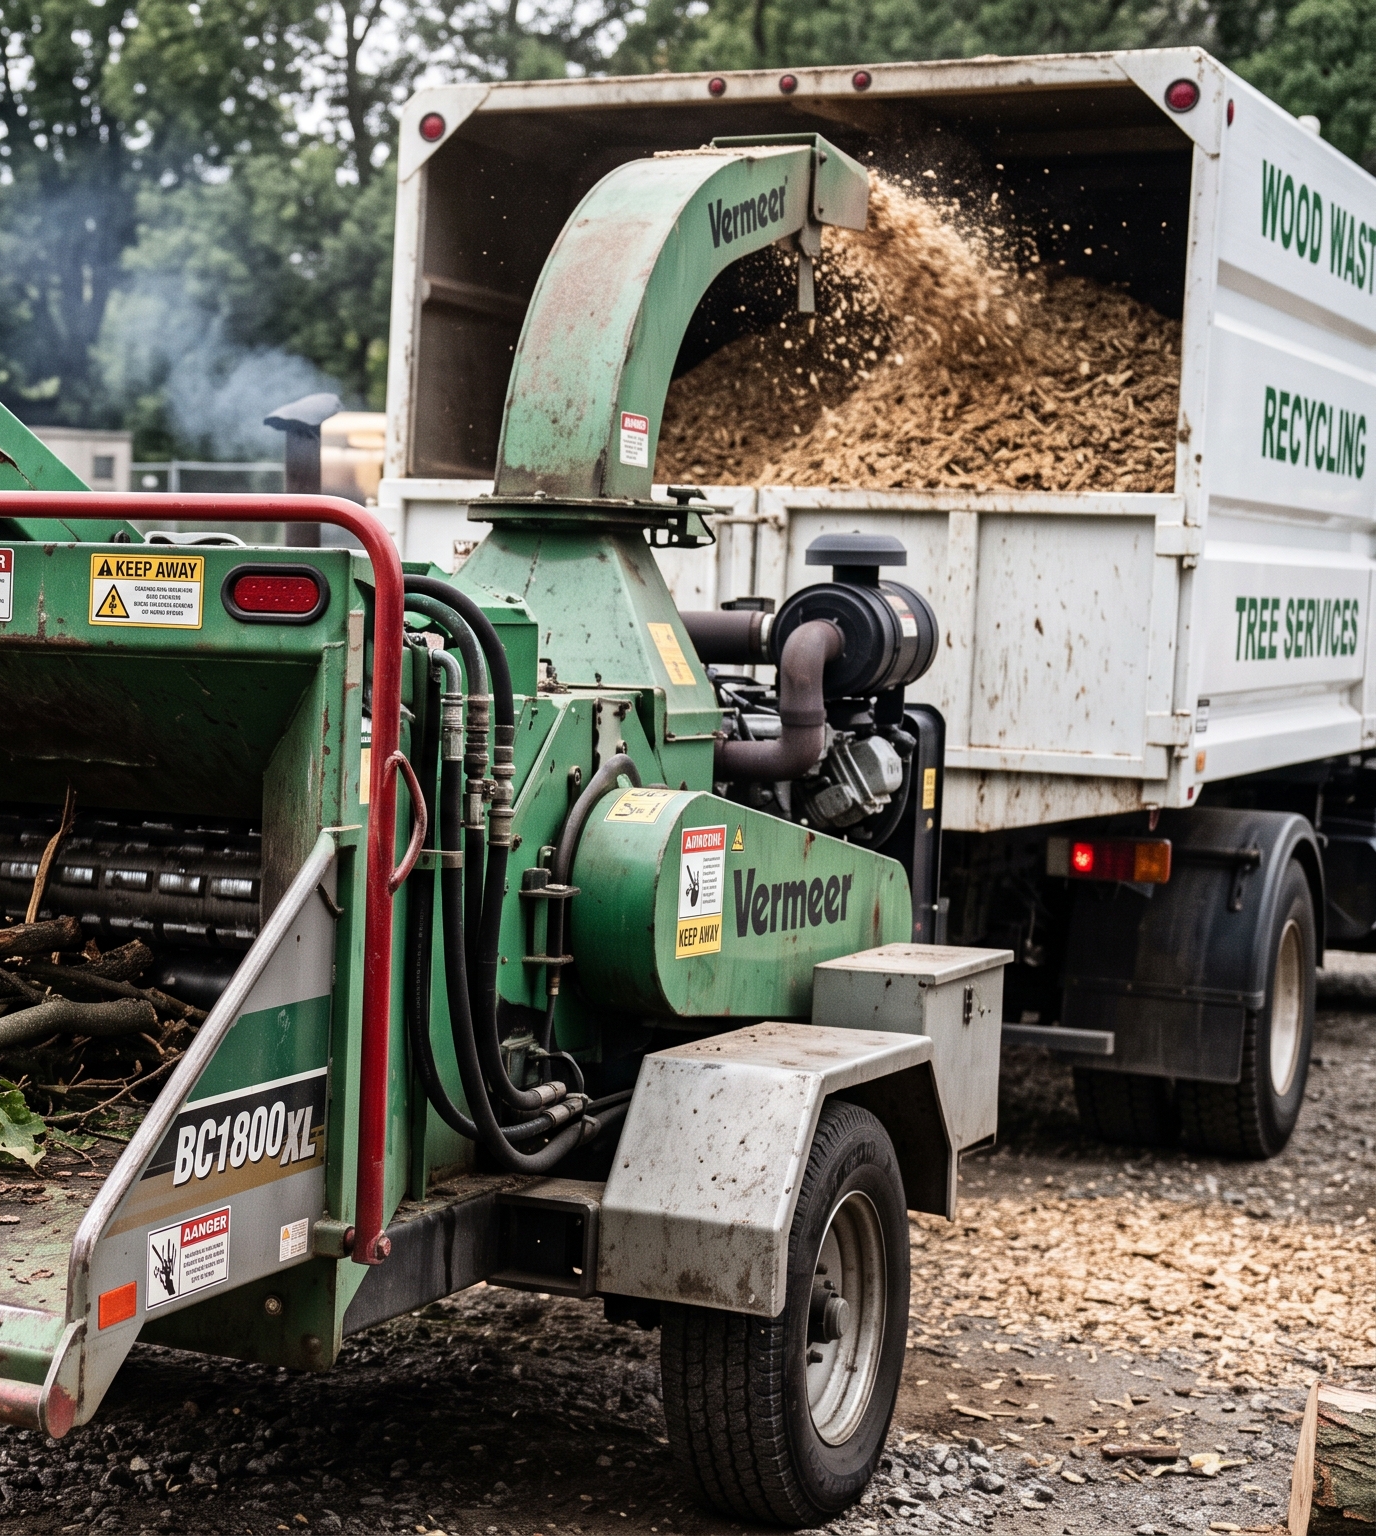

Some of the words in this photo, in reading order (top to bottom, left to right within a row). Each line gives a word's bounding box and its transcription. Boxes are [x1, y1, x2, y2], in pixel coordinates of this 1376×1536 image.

[707, 185, 786, 249] Vermeer
[1262, 158, 1323, 265] WOOD
[1261, 384, 1367, 480] RECYCLING
[115, 560, 153, 577] KEEP
[155, 561, 198, 579] AWAY
[1235, 596, 1280, 661] TREE
[1283, 597, 1359, 660] SERVICES
[733, 867, 853, 938] Vermeer
[679, 926, 698, 948] KEEP
[698, 923, 720, 945] AWAY
